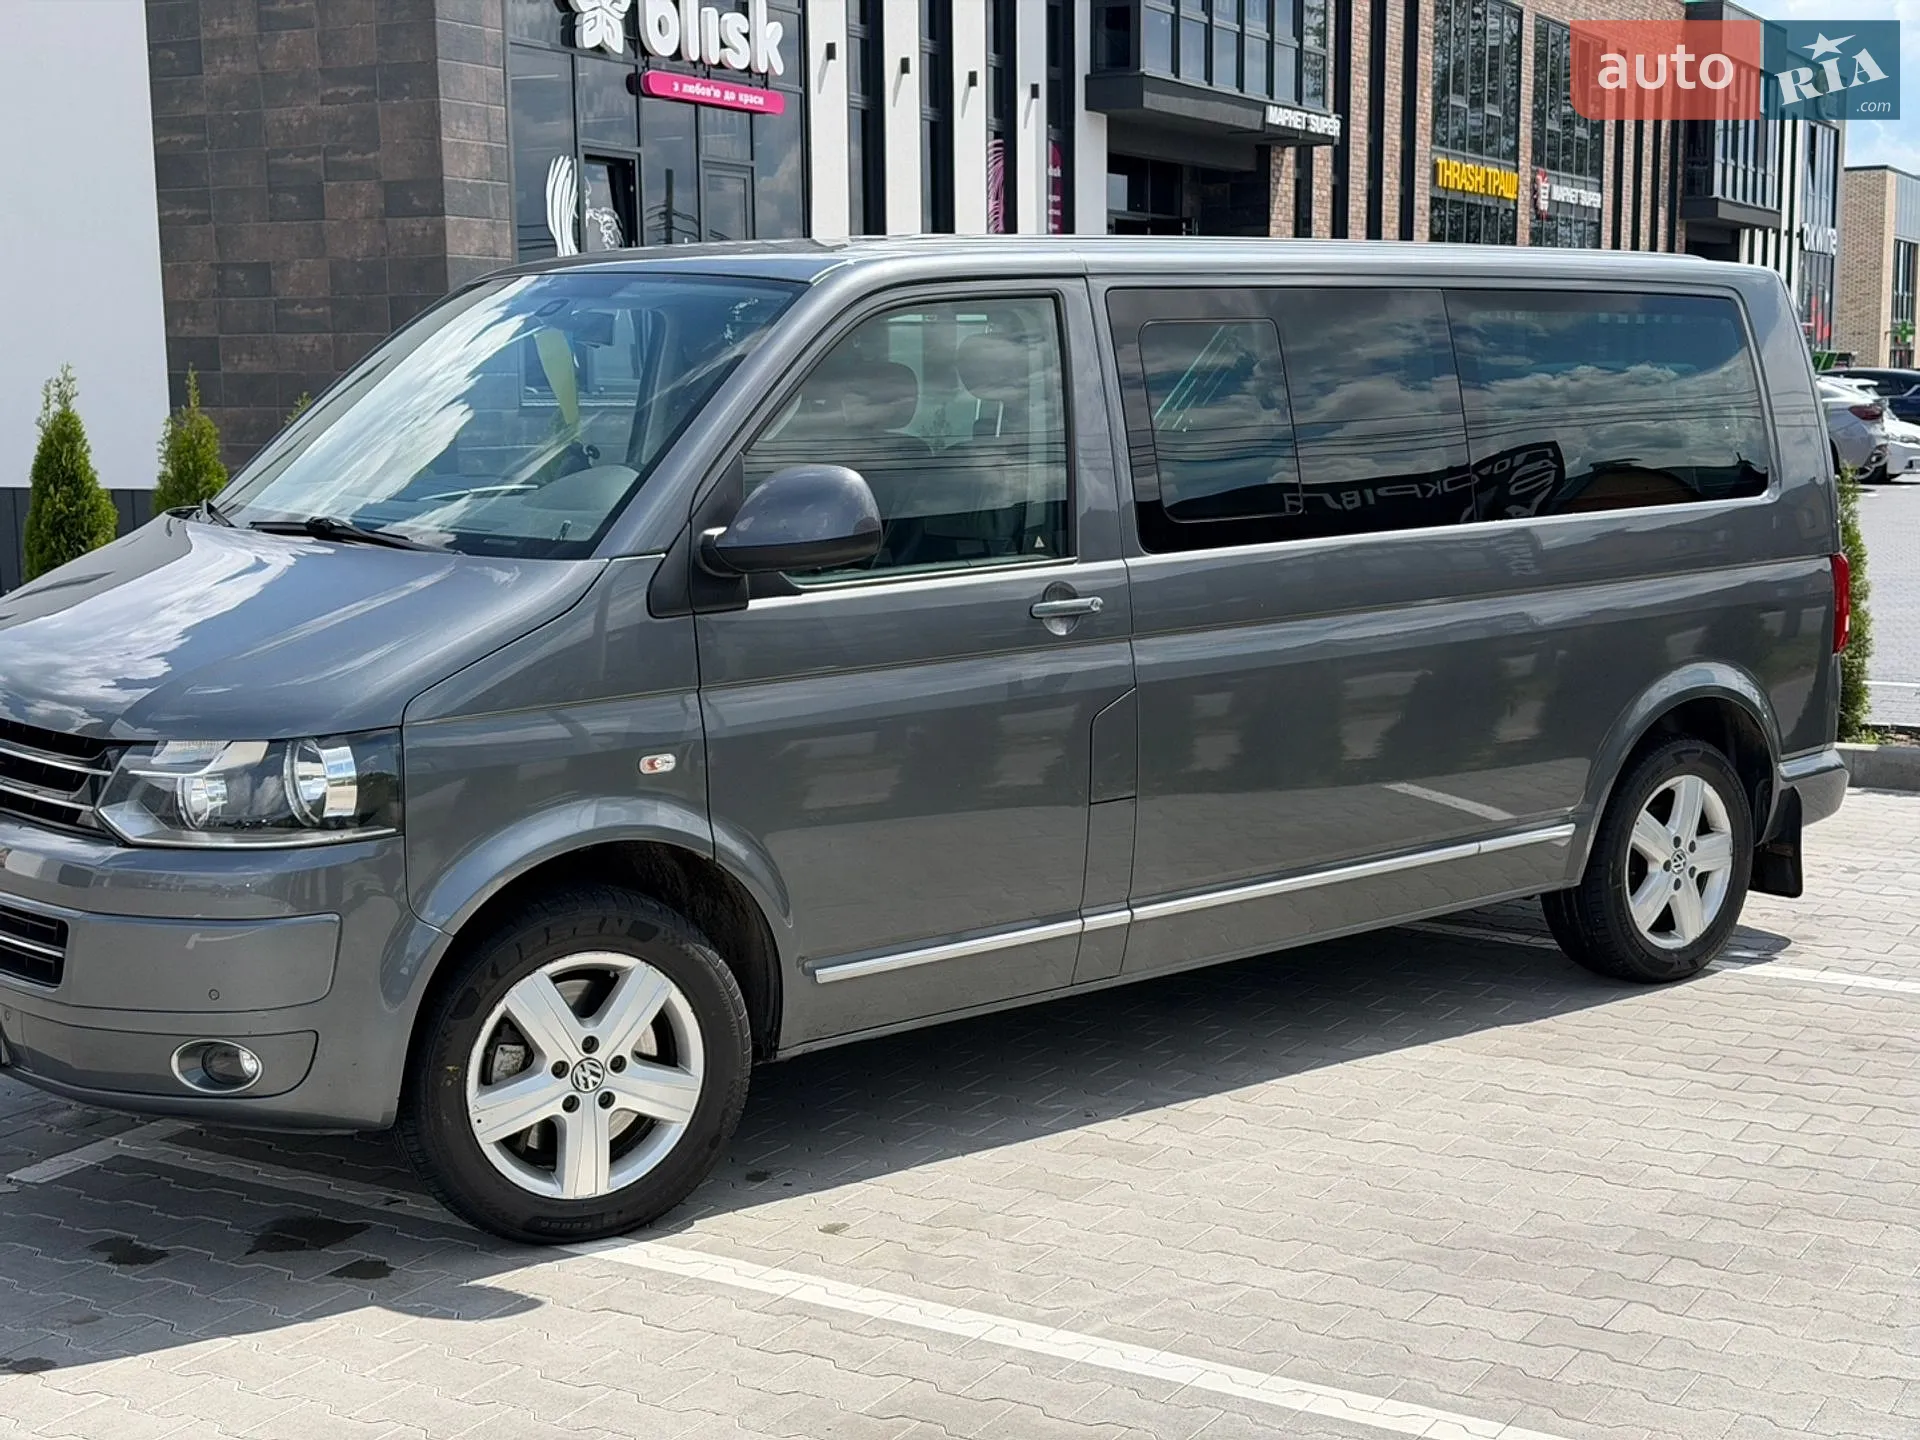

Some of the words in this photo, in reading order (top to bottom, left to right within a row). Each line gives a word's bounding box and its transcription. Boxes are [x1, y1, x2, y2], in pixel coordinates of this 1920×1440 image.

[638, 0, 784, 76] blisk
[723, 90, 736, 102] до
[738, 92, 765, 106] краси
